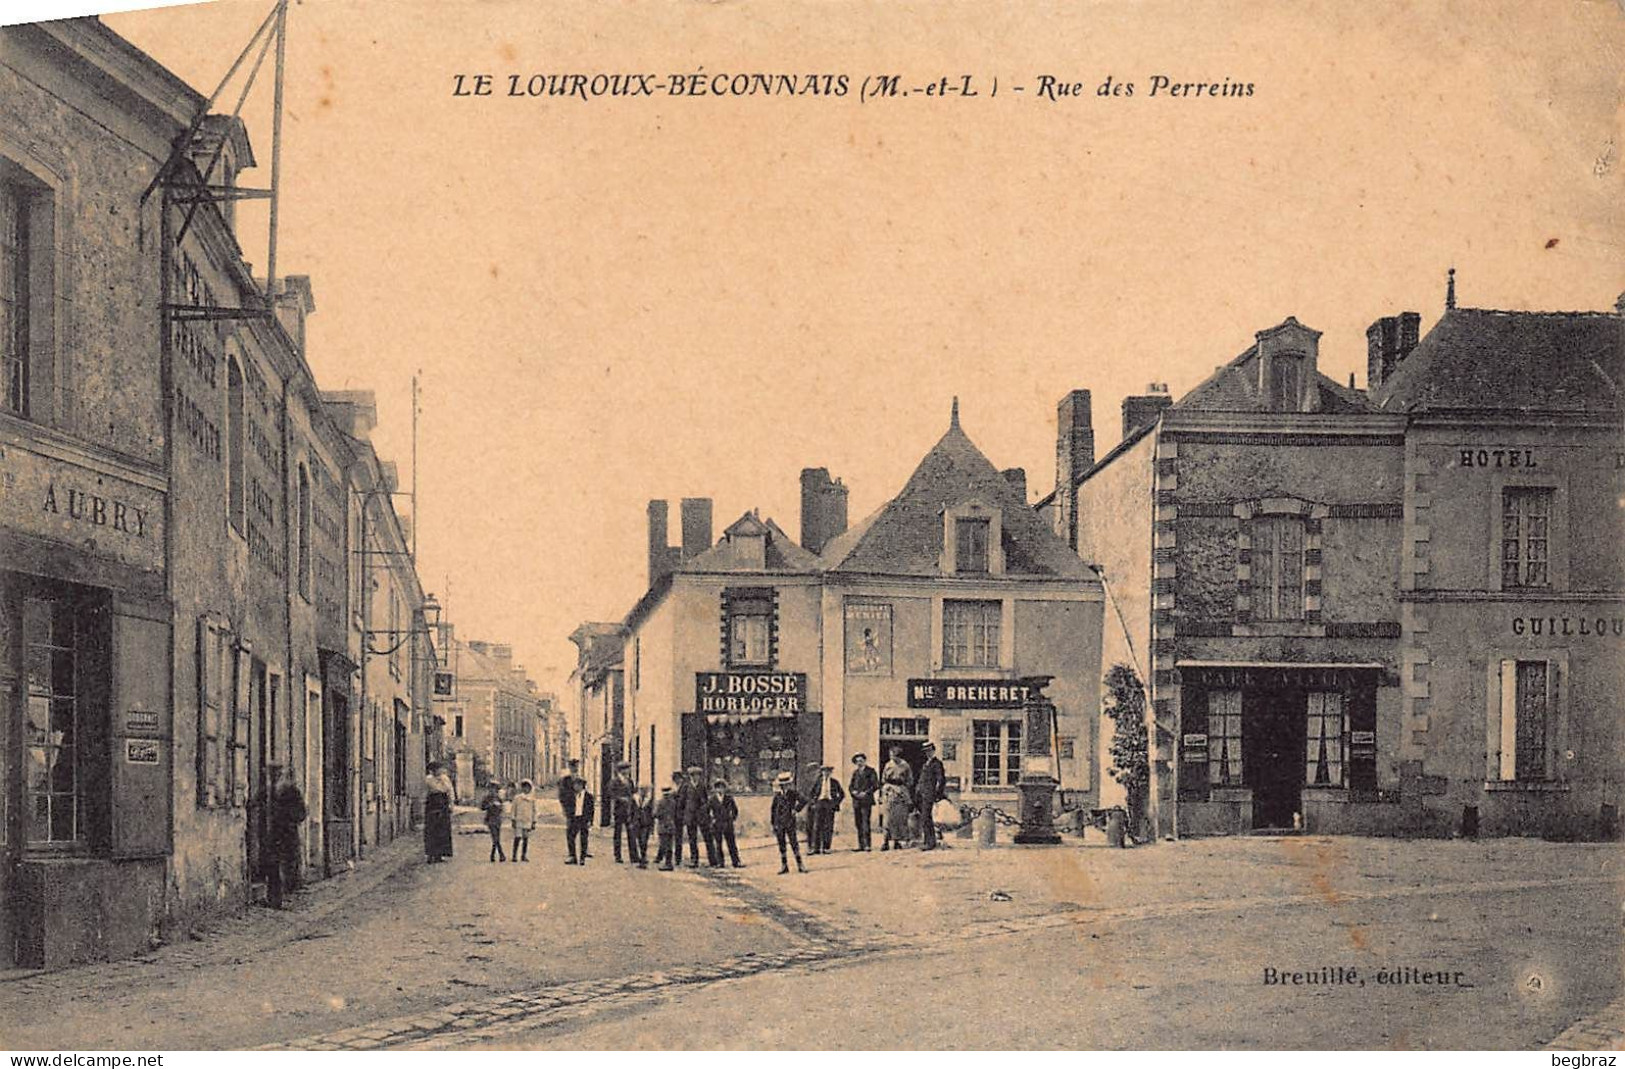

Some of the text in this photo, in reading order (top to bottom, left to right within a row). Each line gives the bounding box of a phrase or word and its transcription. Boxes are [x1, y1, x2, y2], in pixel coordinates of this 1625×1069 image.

[1460, 450, 1537, 468] HOTEL
[43, 484, 149, 537] AUBRY
[703, 676, 723, 694] J.
[946, 686, 1030, 701] BREHERET
[702, 696, 799, 711] HORLOGER
